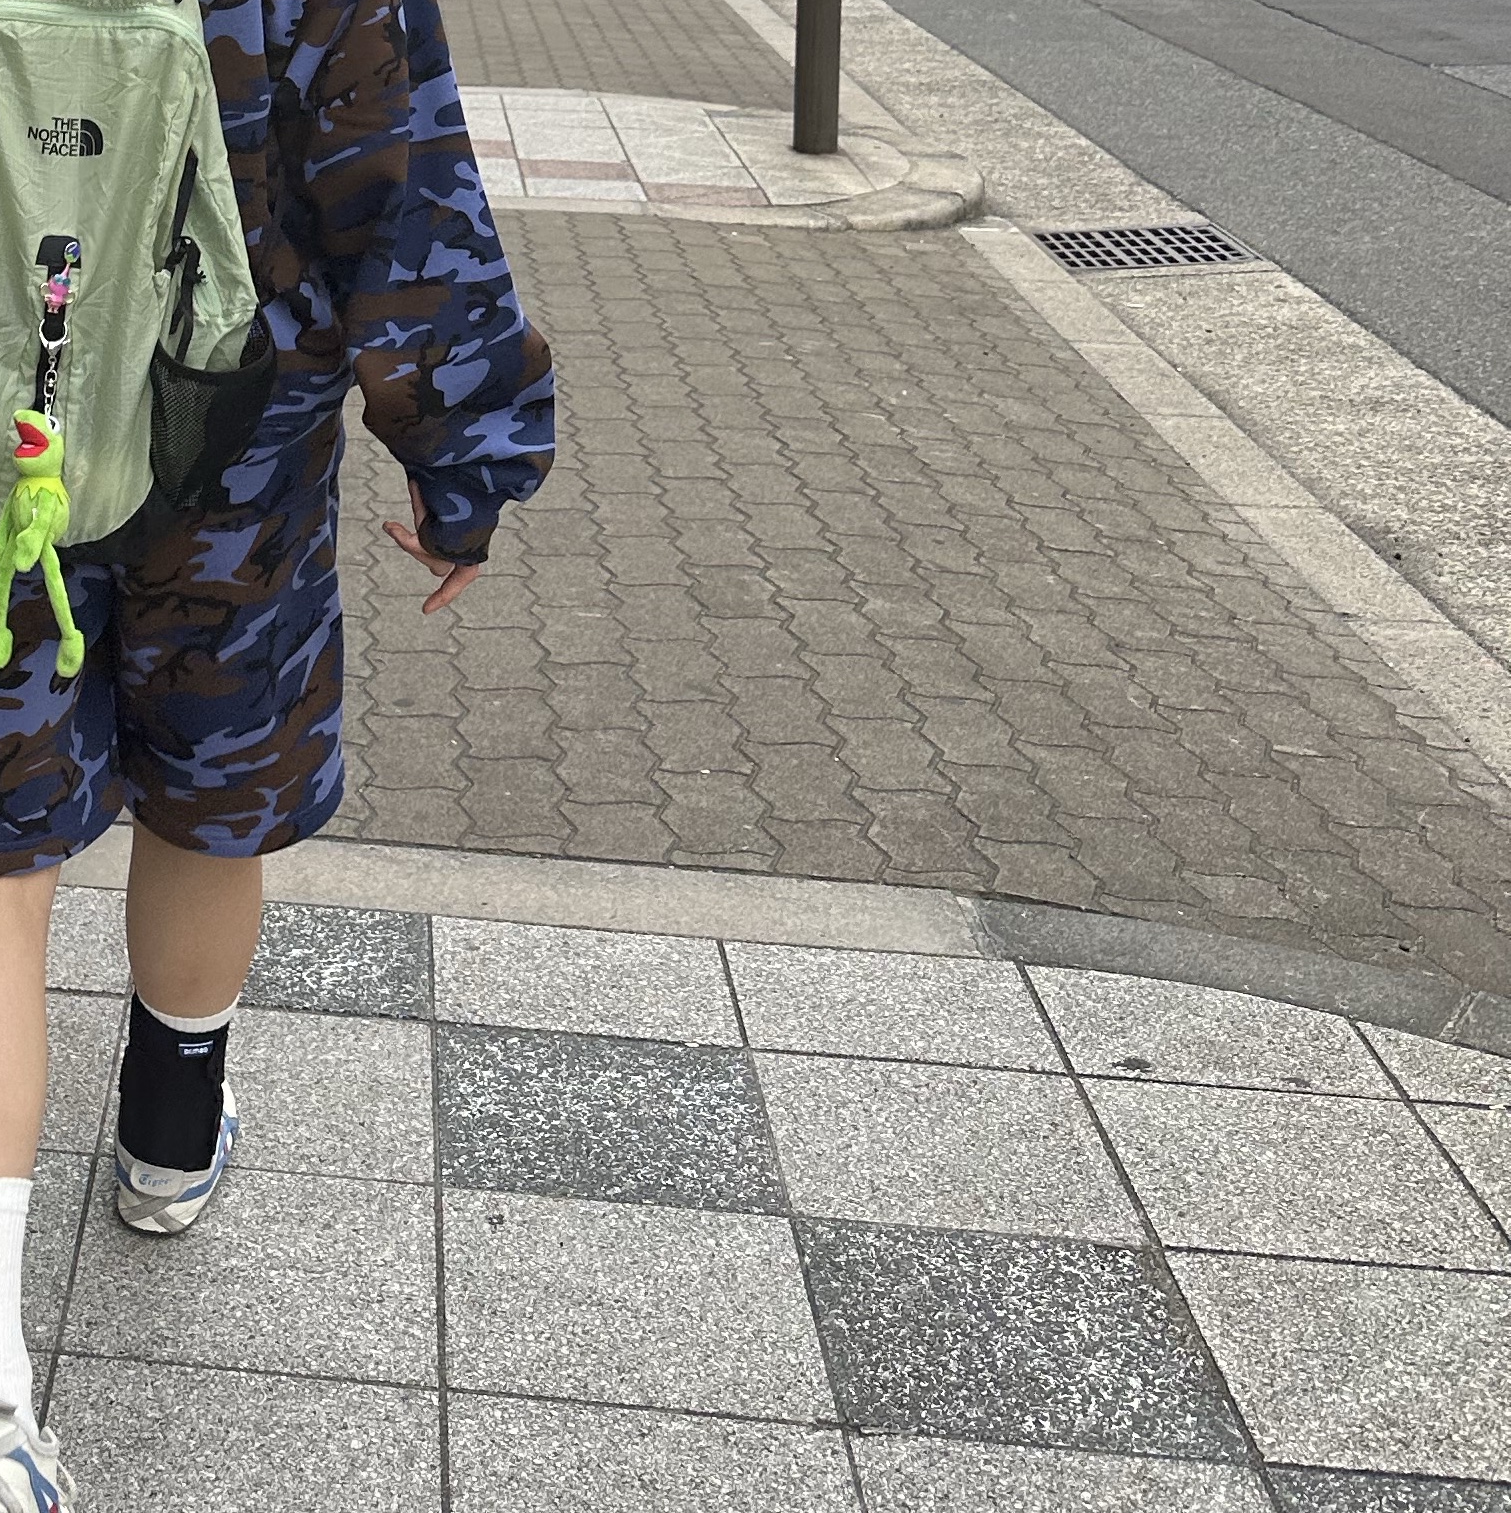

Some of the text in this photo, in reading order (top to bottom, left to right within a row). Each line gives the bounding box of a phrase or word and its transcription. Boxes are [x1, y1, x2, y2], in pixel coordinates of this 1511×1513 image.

[51, 116, 80, 131] THE
[27, 126, 79, 144] NORTH
[41, 142, 79, 157] FACE
